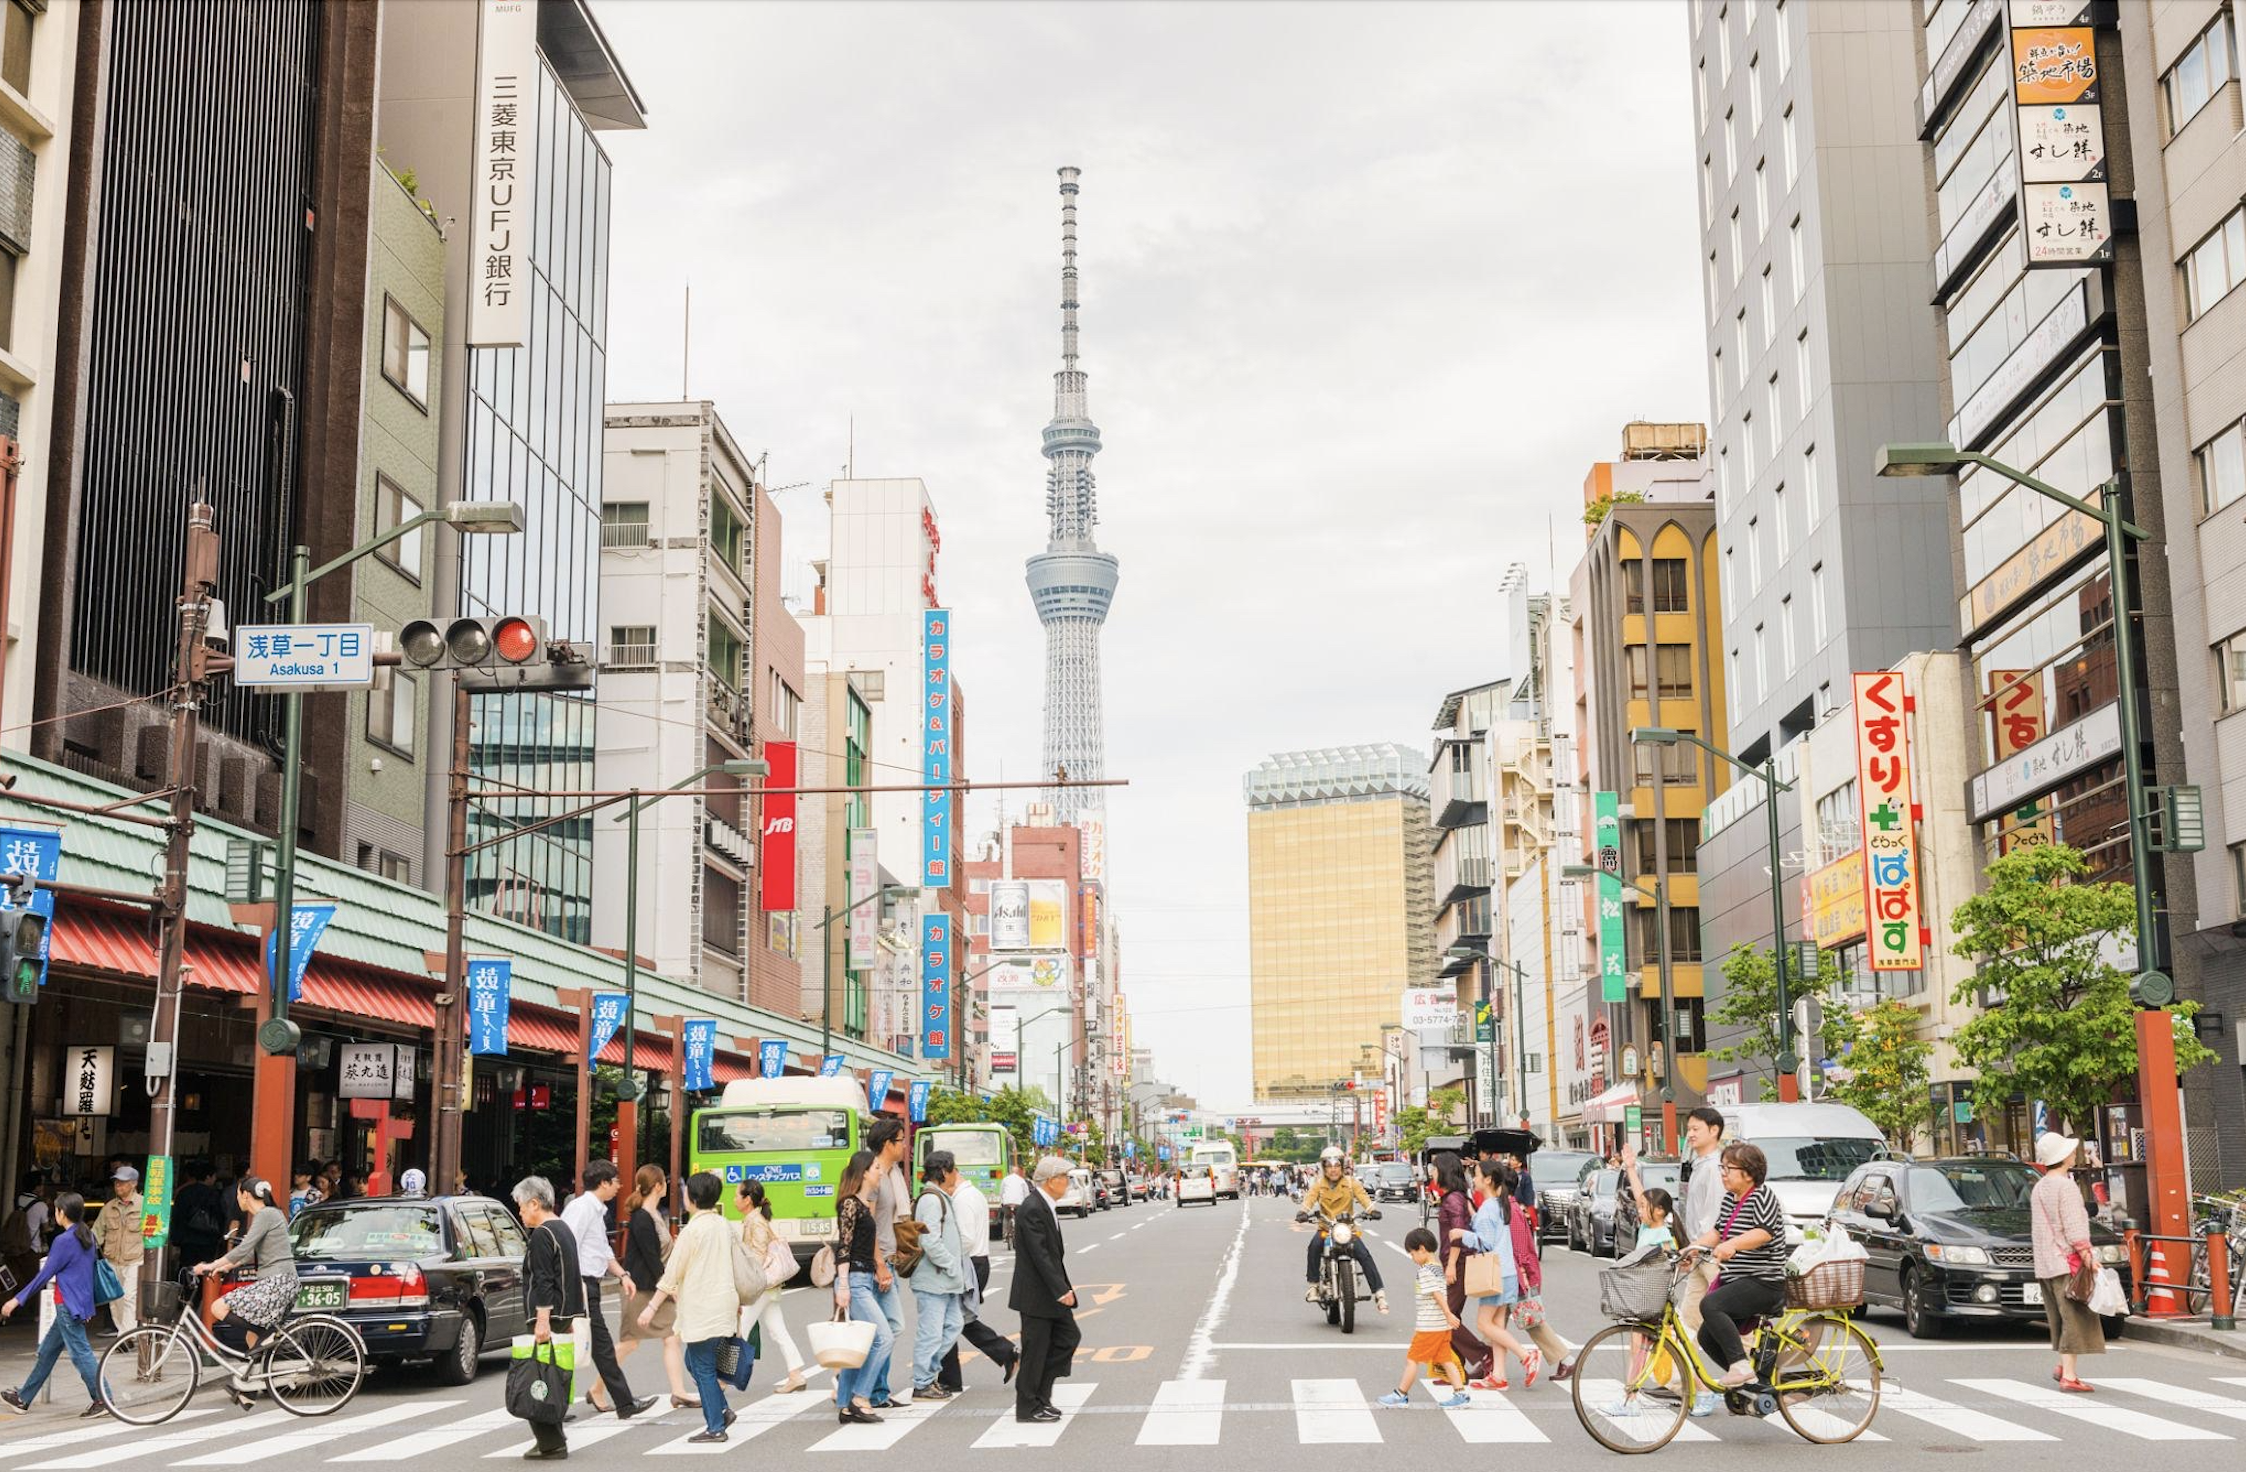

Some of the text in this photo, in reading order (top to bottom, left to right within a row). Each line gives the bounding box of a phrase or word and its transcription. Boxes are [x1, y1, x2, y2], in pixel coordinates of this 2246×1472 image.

[2079, 14, 2089, 23] 4F
[2018, 58, 2094, 82] 築地市場
[2084, 90, 2095, 99] 3F
[2030, 139, 2092, 161] すし鮮
[2091, 169, 2103, 179] 2F
[485, 75, 517, 307] 三菱東京UFJ銀行
[2036, 217, 2098, 240] すし鮮
[2100, 249, 2111, 259] 1F
[248, 633, 359, 659] 浅草一丁目
[270, 662, 338, 675] Asakusa 1
[1864, 676, 1901, 793] くすり
[765, 817, 793, 836] JTB
[1874, 849, 1911, 954] ぱぱす
[994, 905, 1026, 919] Asahi
[930, 926, 945, 1047] カラオケ館
[307, 1292, 341, 1305] 96-05
